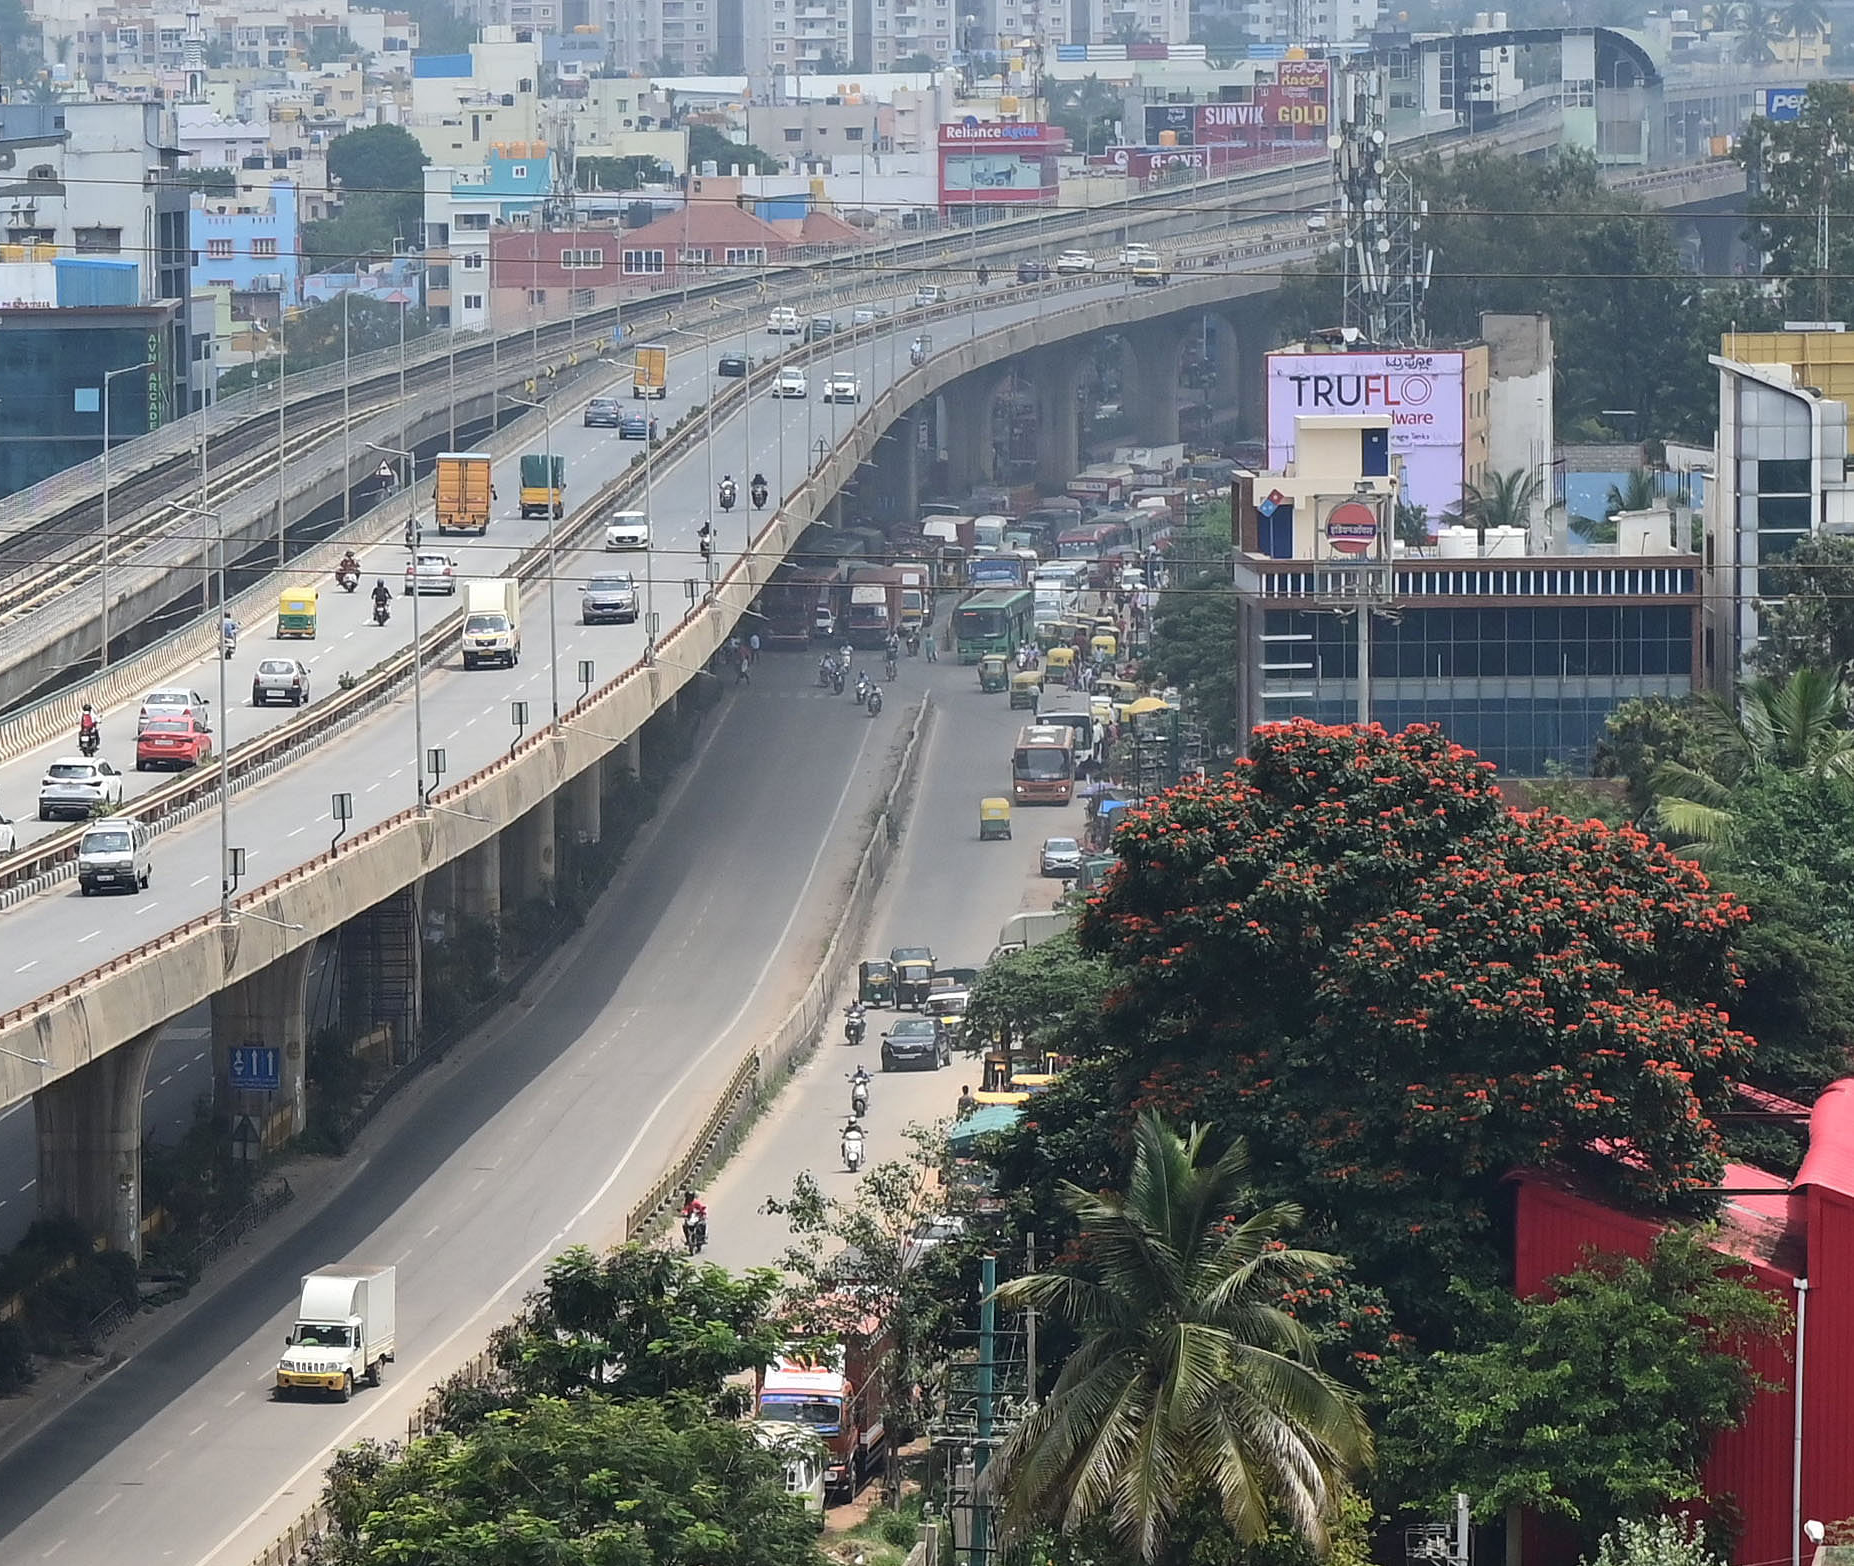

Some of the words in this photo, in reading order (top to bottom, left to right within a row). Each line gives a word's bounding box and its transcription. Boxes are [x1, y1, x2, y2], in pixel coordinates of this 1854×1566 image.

[1205, 106, 1264, 125] SUNVIK
[1277, 105, 1327, 126] GOLD
[946, 124, 1002, 139] Reliance
[148, 334, 157, 362] AVN
[148, 373, 158, 431] ARCADE
[1289, 374, 1433, 407] TRUFLO
